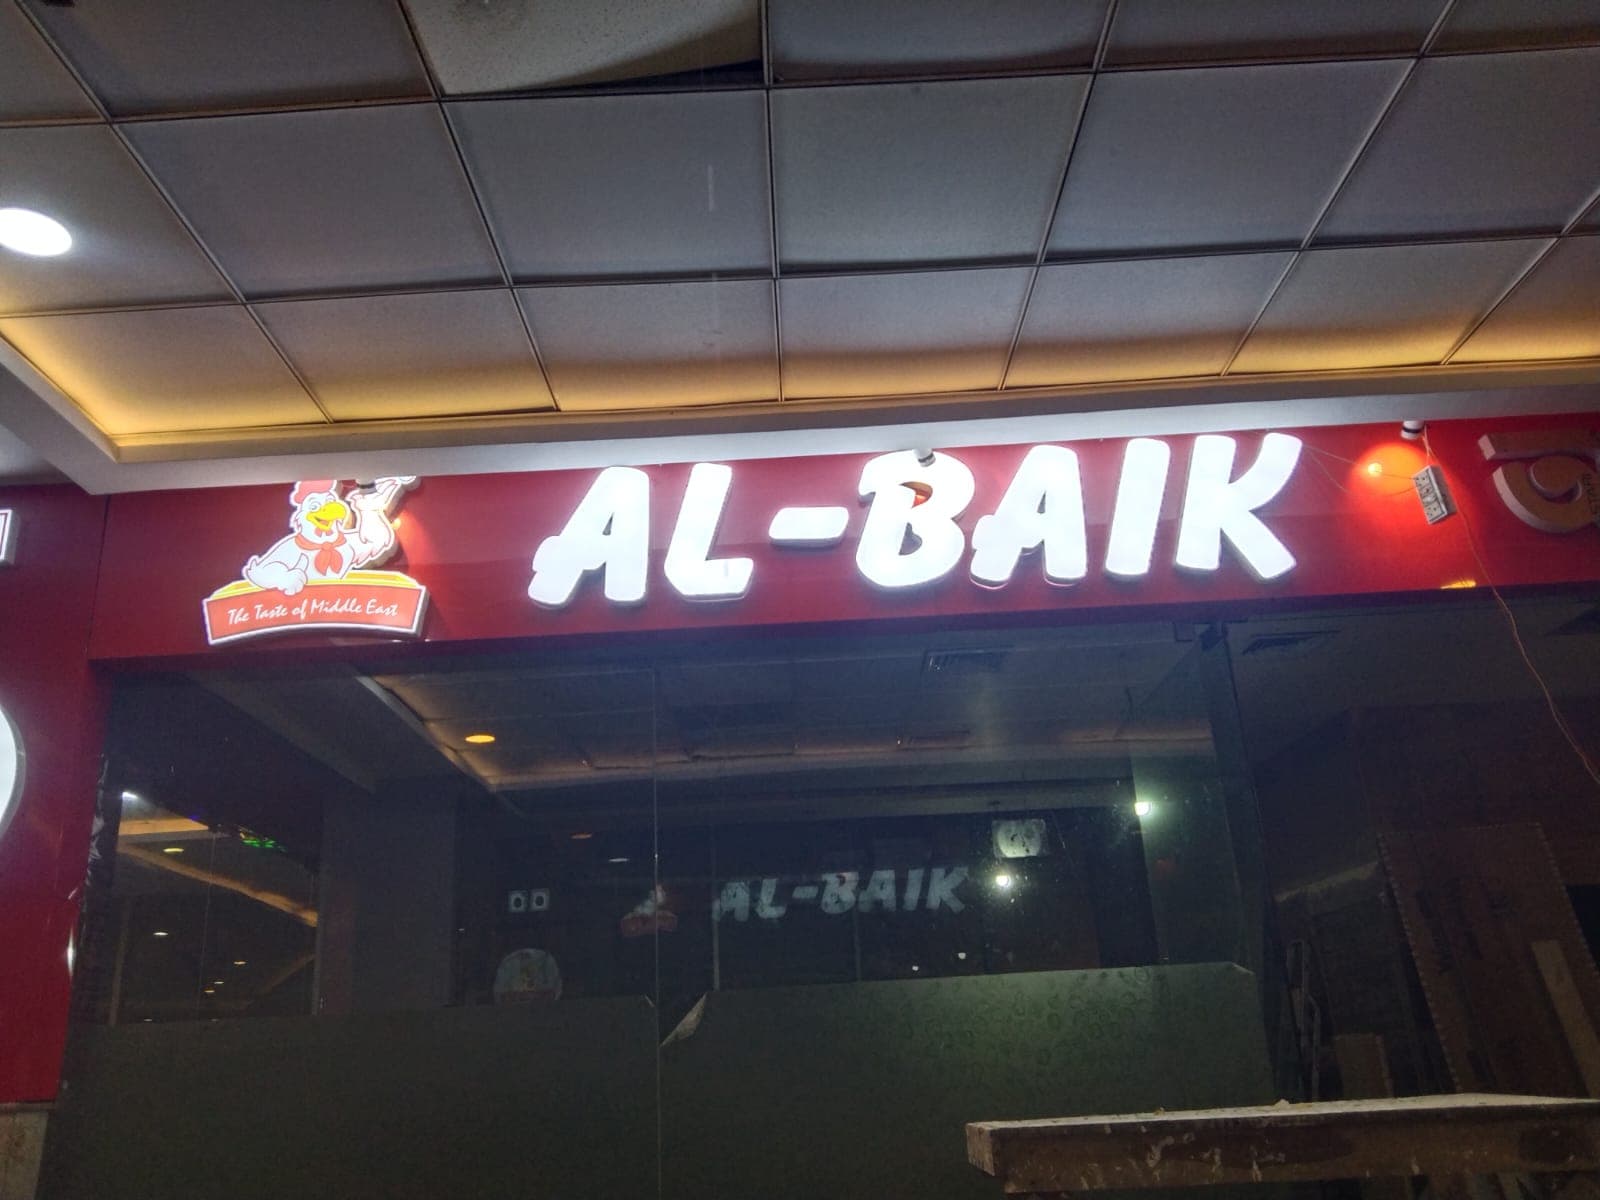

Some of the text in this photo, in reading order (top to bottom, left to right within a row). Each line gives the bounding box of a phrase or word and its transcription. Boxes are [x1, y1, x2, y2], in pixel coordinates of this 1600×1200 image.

[528, 433, 1303, 607] AL-BAIK
[227, 597, 399, 624] The Taste of Middle East
[711, 866, 969, 922] AL-BAIK
